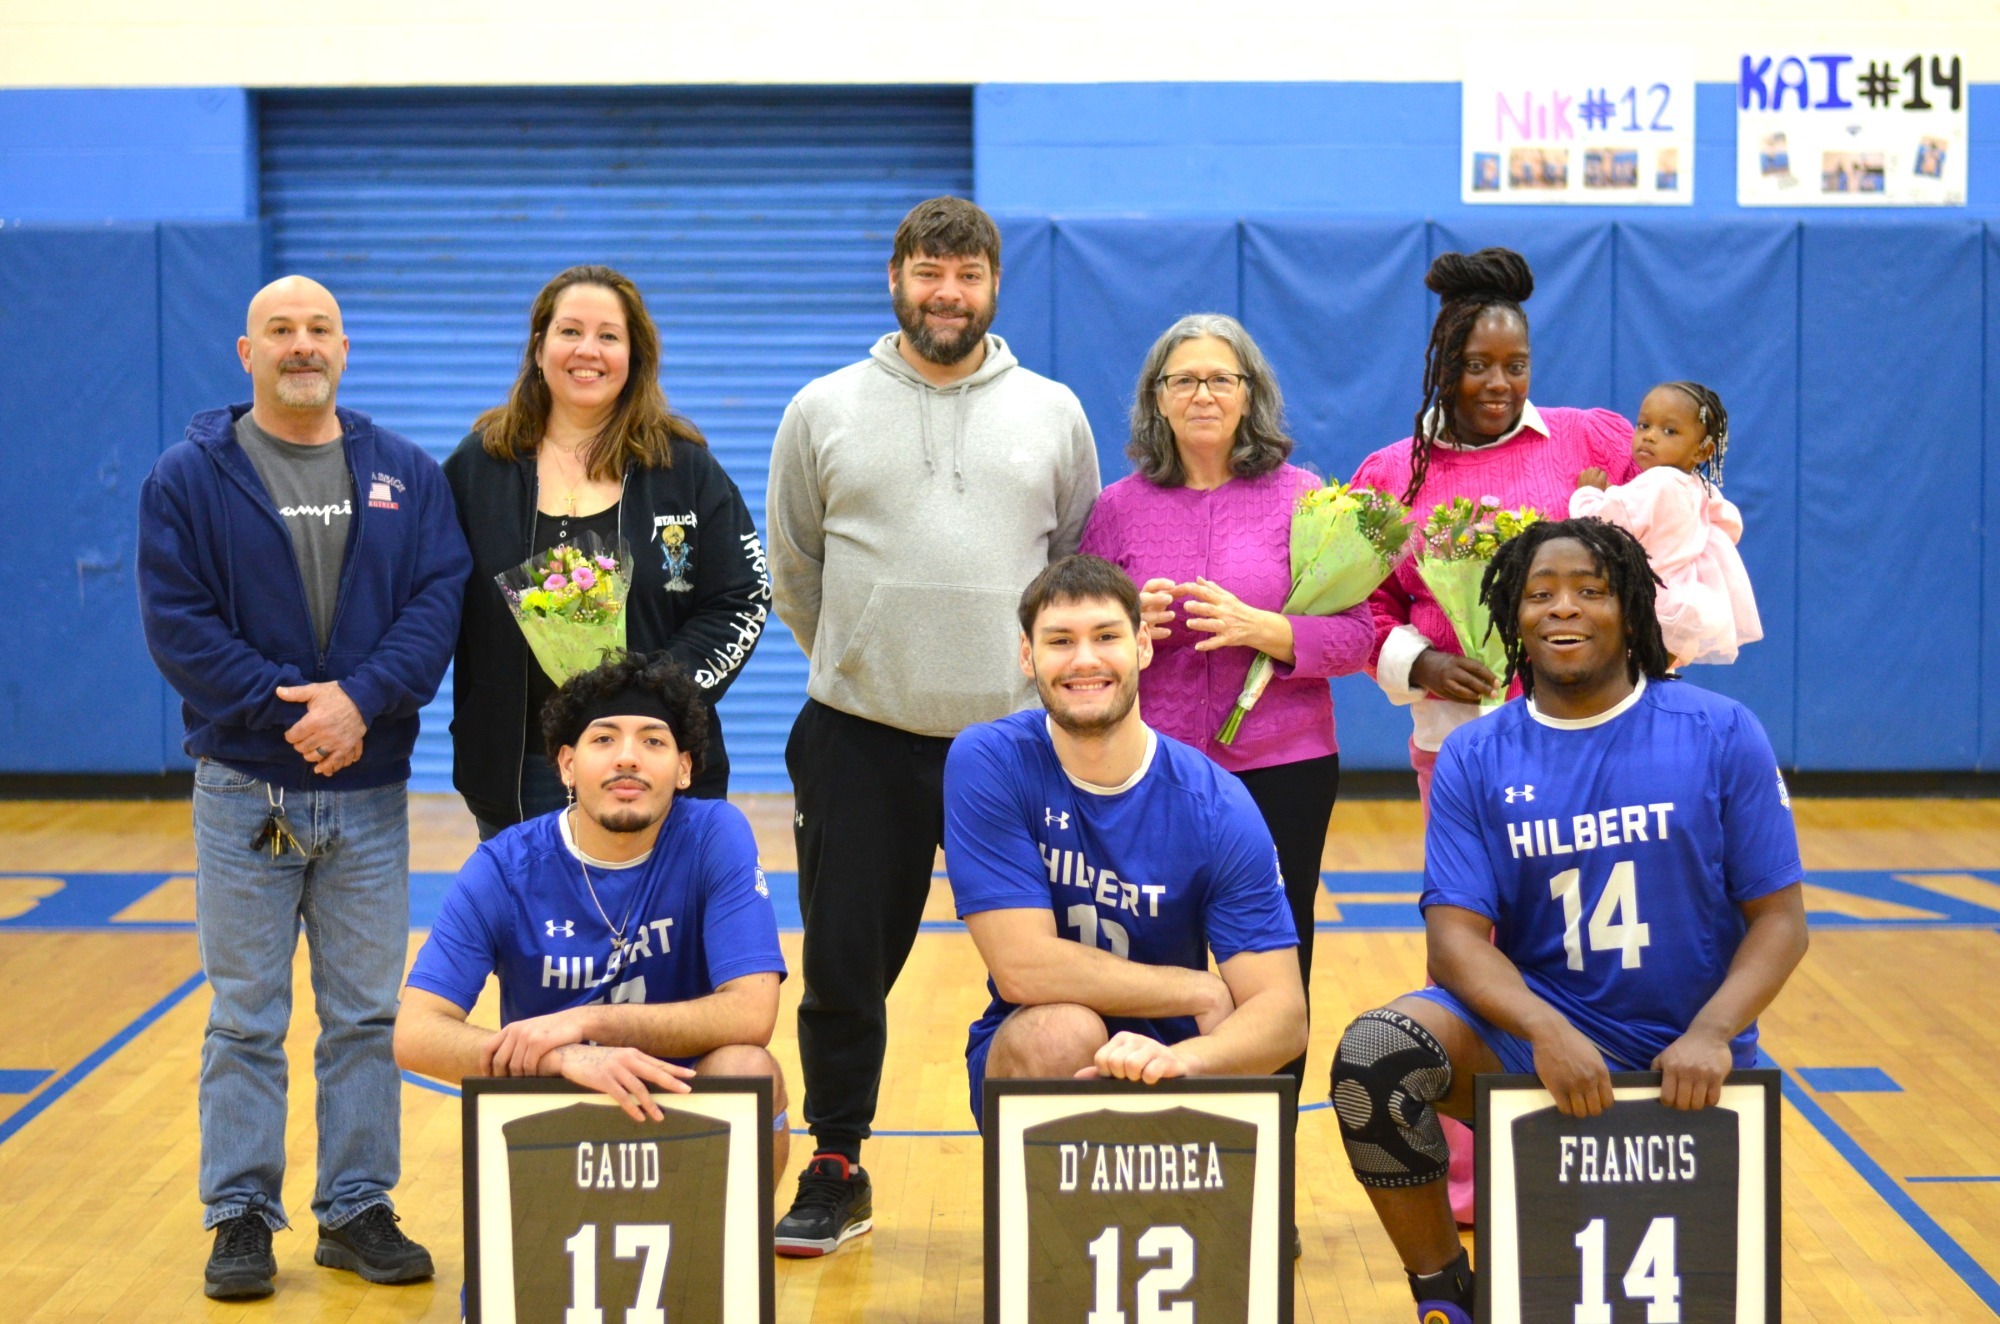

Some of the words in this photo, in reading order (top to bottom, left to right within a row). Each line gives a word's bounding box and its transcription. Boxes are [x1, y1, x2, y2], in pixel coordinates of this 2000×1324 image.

[1507, 802, 1674, 858] HILBERT
[1550, 861, 1650, 971] 14
[577, 1142, 660, 1188] GAUD
[1060, 1140, 1224, 1191] D'ANDREA
[1559, 1135, 1696, 1182] FRANCIS
[566, 1224, 671, 1324] 17
[1088, 1226, 1194, 1324] 12
[1574, 1217, 1681, 1324] 14
